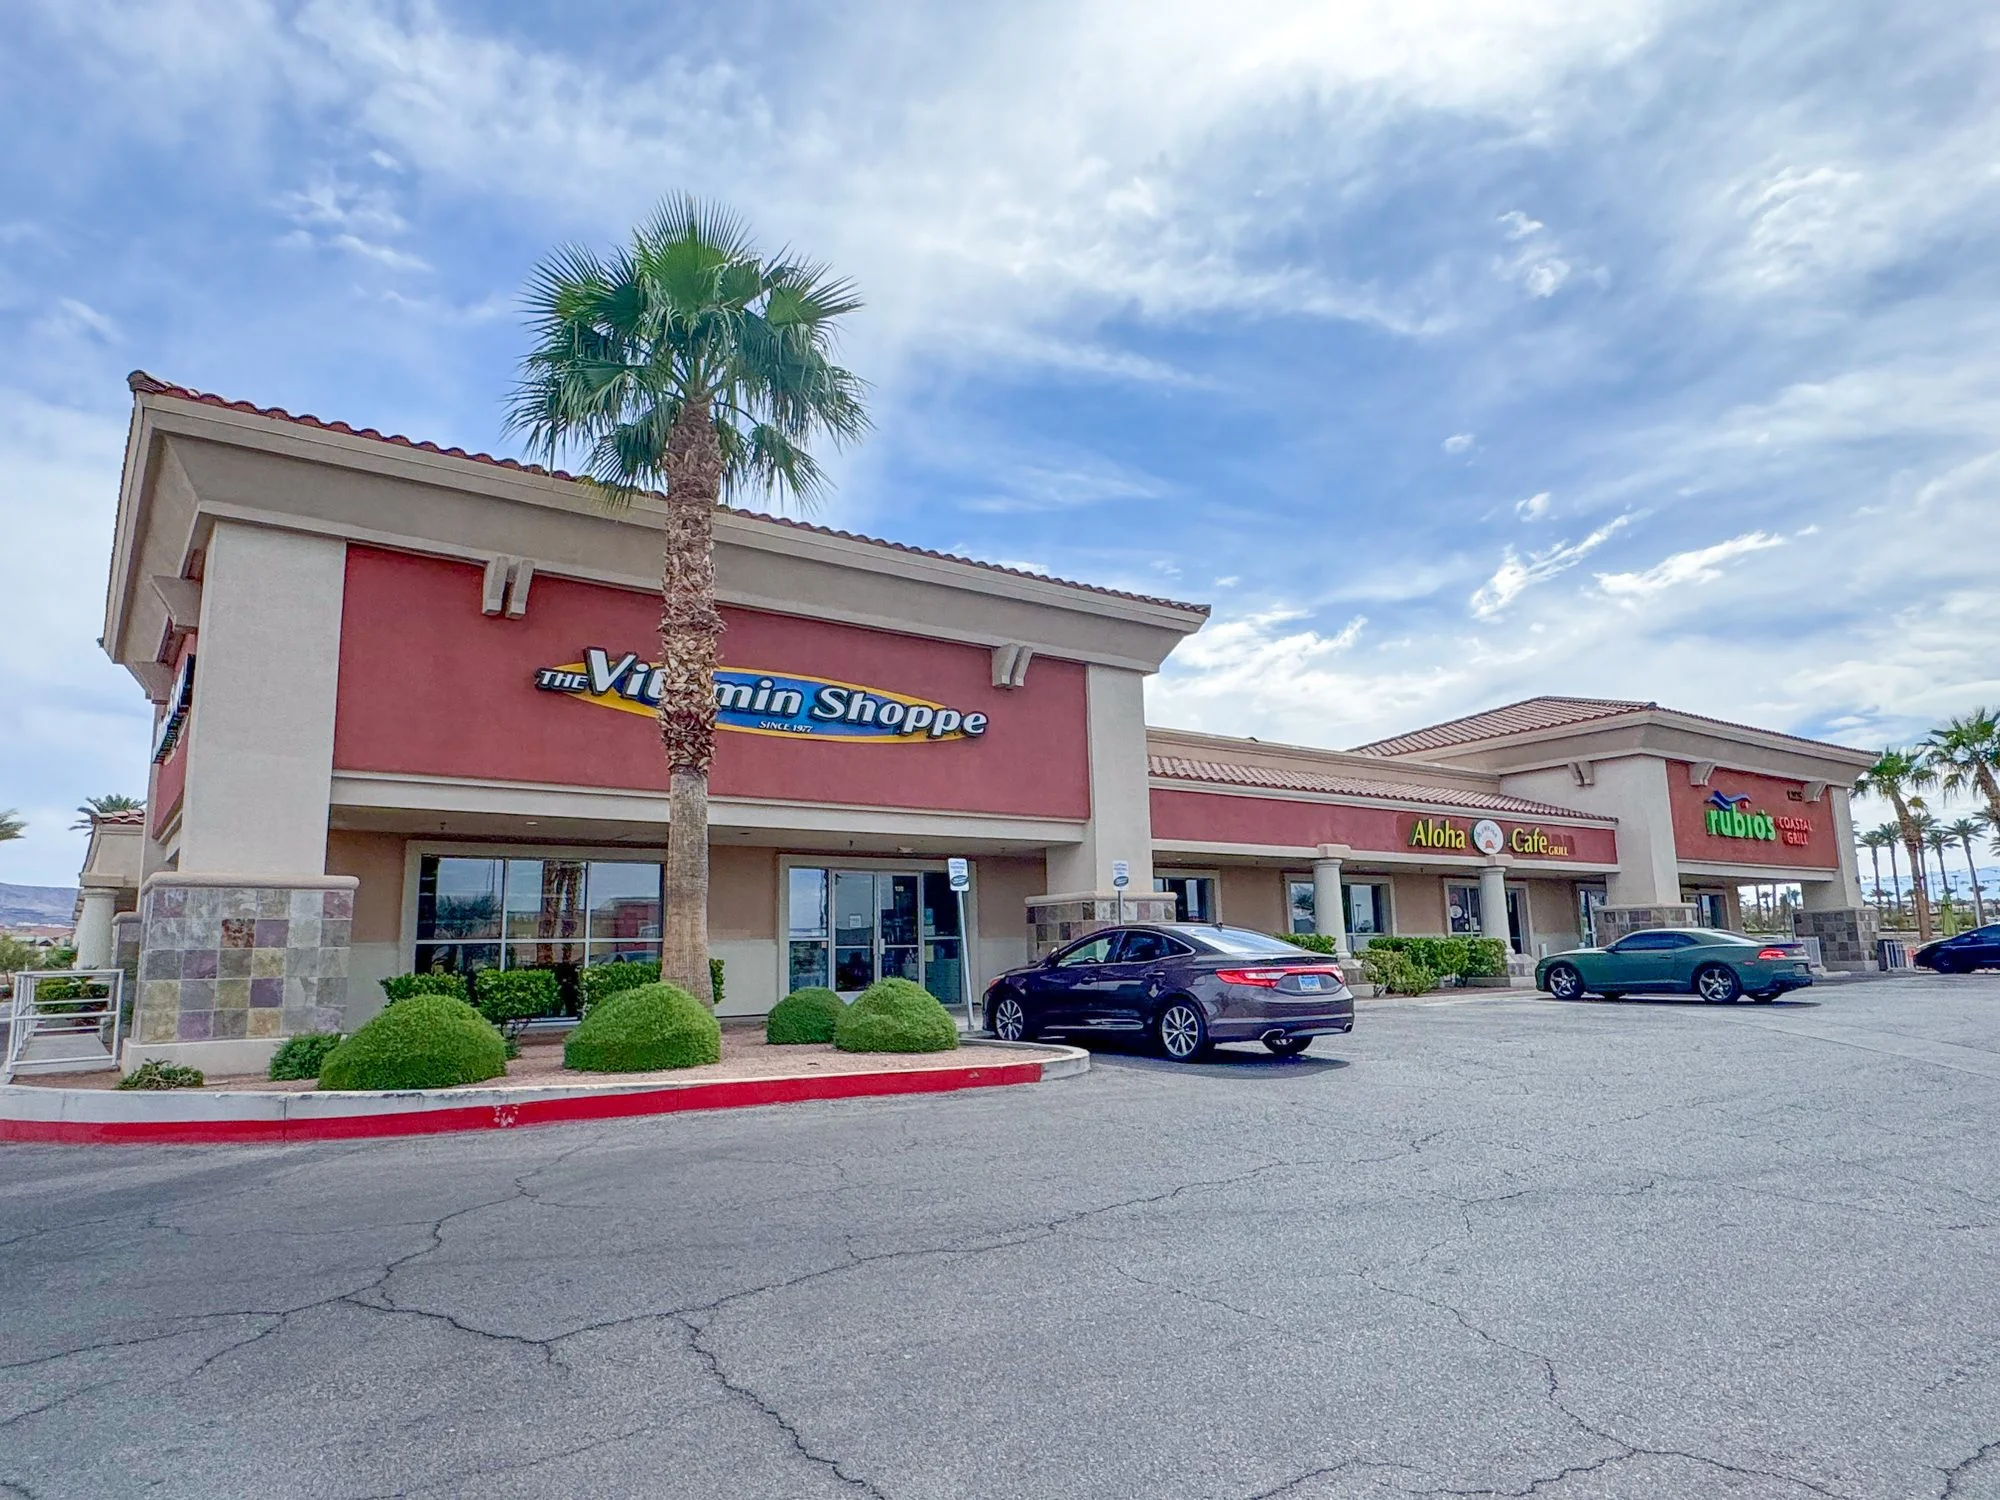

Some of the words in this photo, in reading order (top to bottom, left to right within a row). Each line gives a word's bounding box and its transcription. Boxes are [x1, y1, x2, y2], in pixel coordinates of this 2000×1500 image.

[537, 668, 589, 692] THE
[584, 648, 804, 717] Vitmin
[811, 686, 988, 738] Shoppe
[759, 720, 790, 731] SINCE
[792, 724, 813, 733] 1977
[1778, 816, 1812, 832] COASTAL
[1410, 818, 1466, 849] Aloha
[1547, 845, 1569, 856] GRILL
[1785, 831, 1809, 845] GRILL
